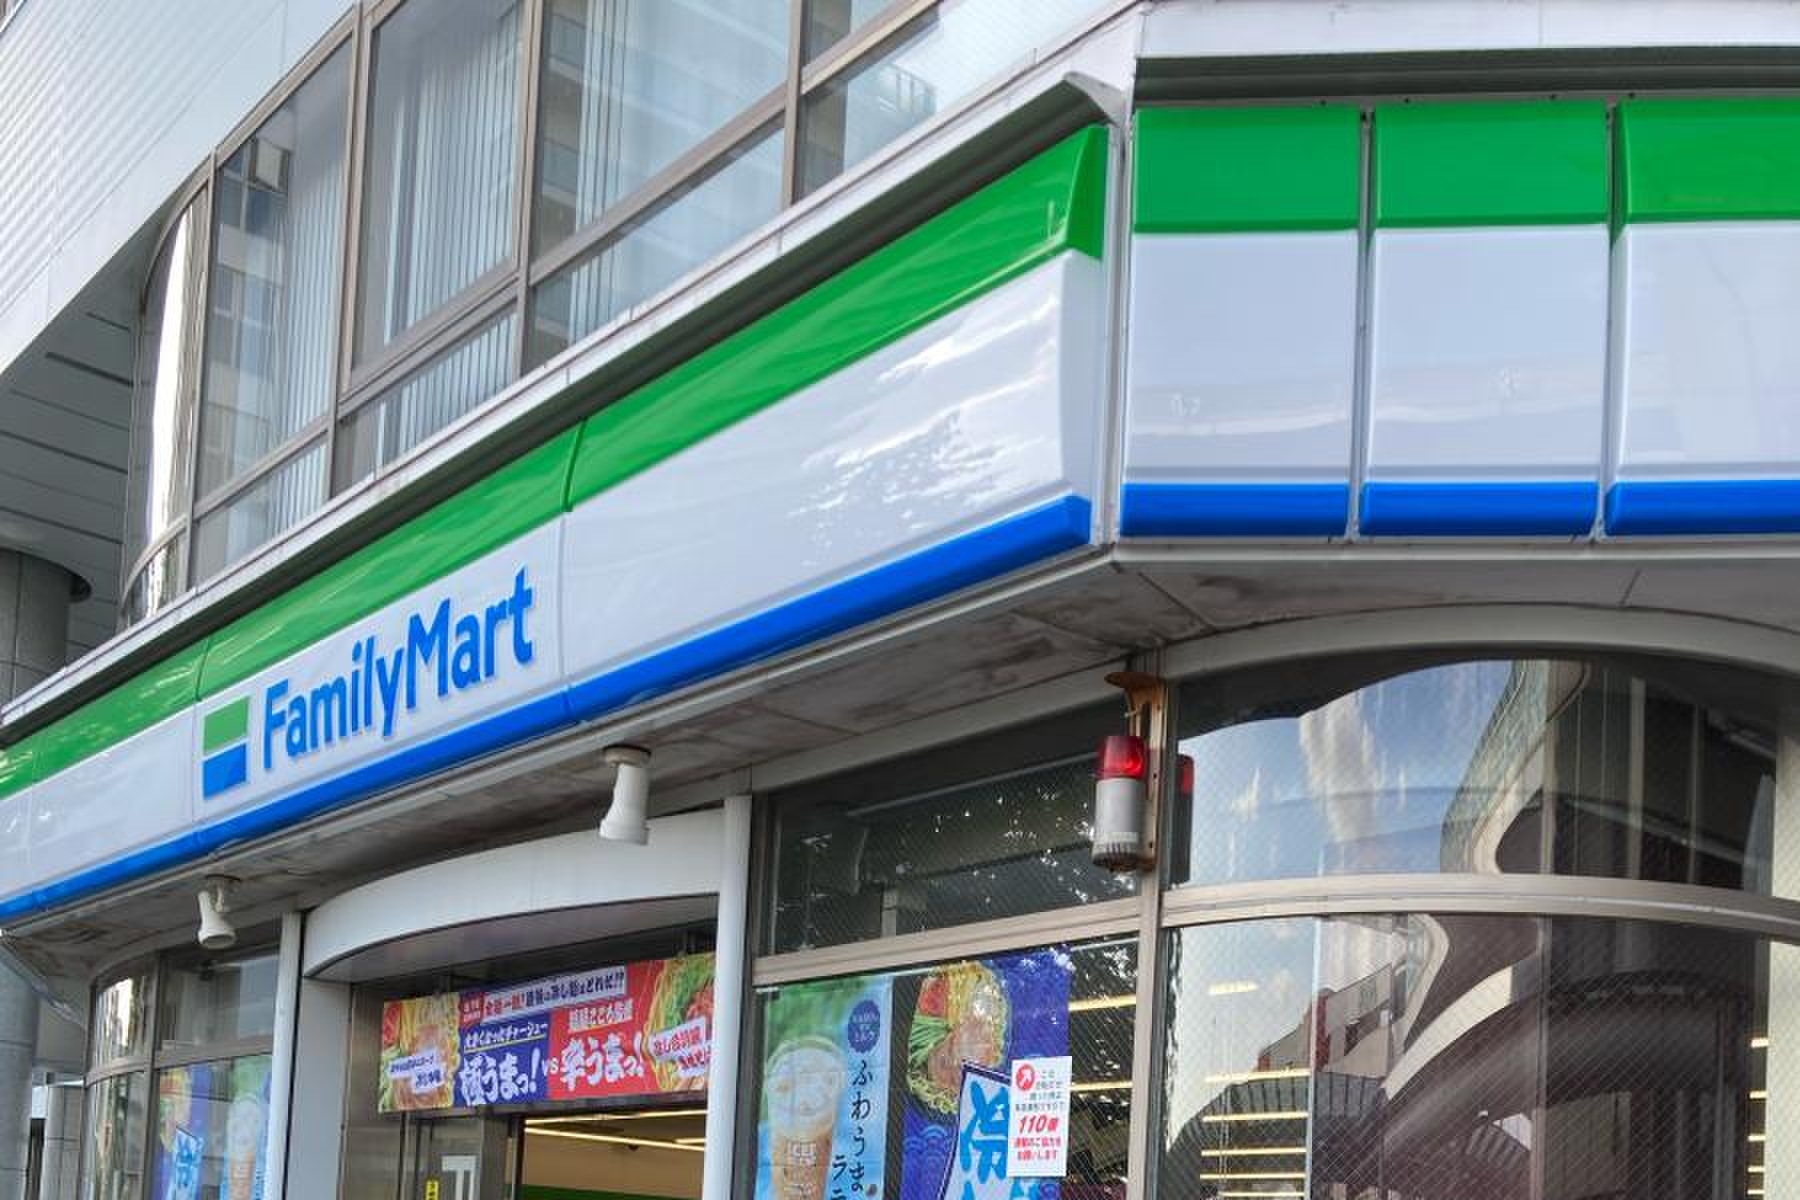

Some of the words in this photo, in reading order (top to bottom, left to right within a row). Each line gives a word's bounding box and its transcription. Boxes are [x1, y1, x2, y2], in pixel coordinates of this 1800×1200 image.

[263, 566, 533, 770] FamilyMart
[850, 1060, 873, 1192] ふわうま
